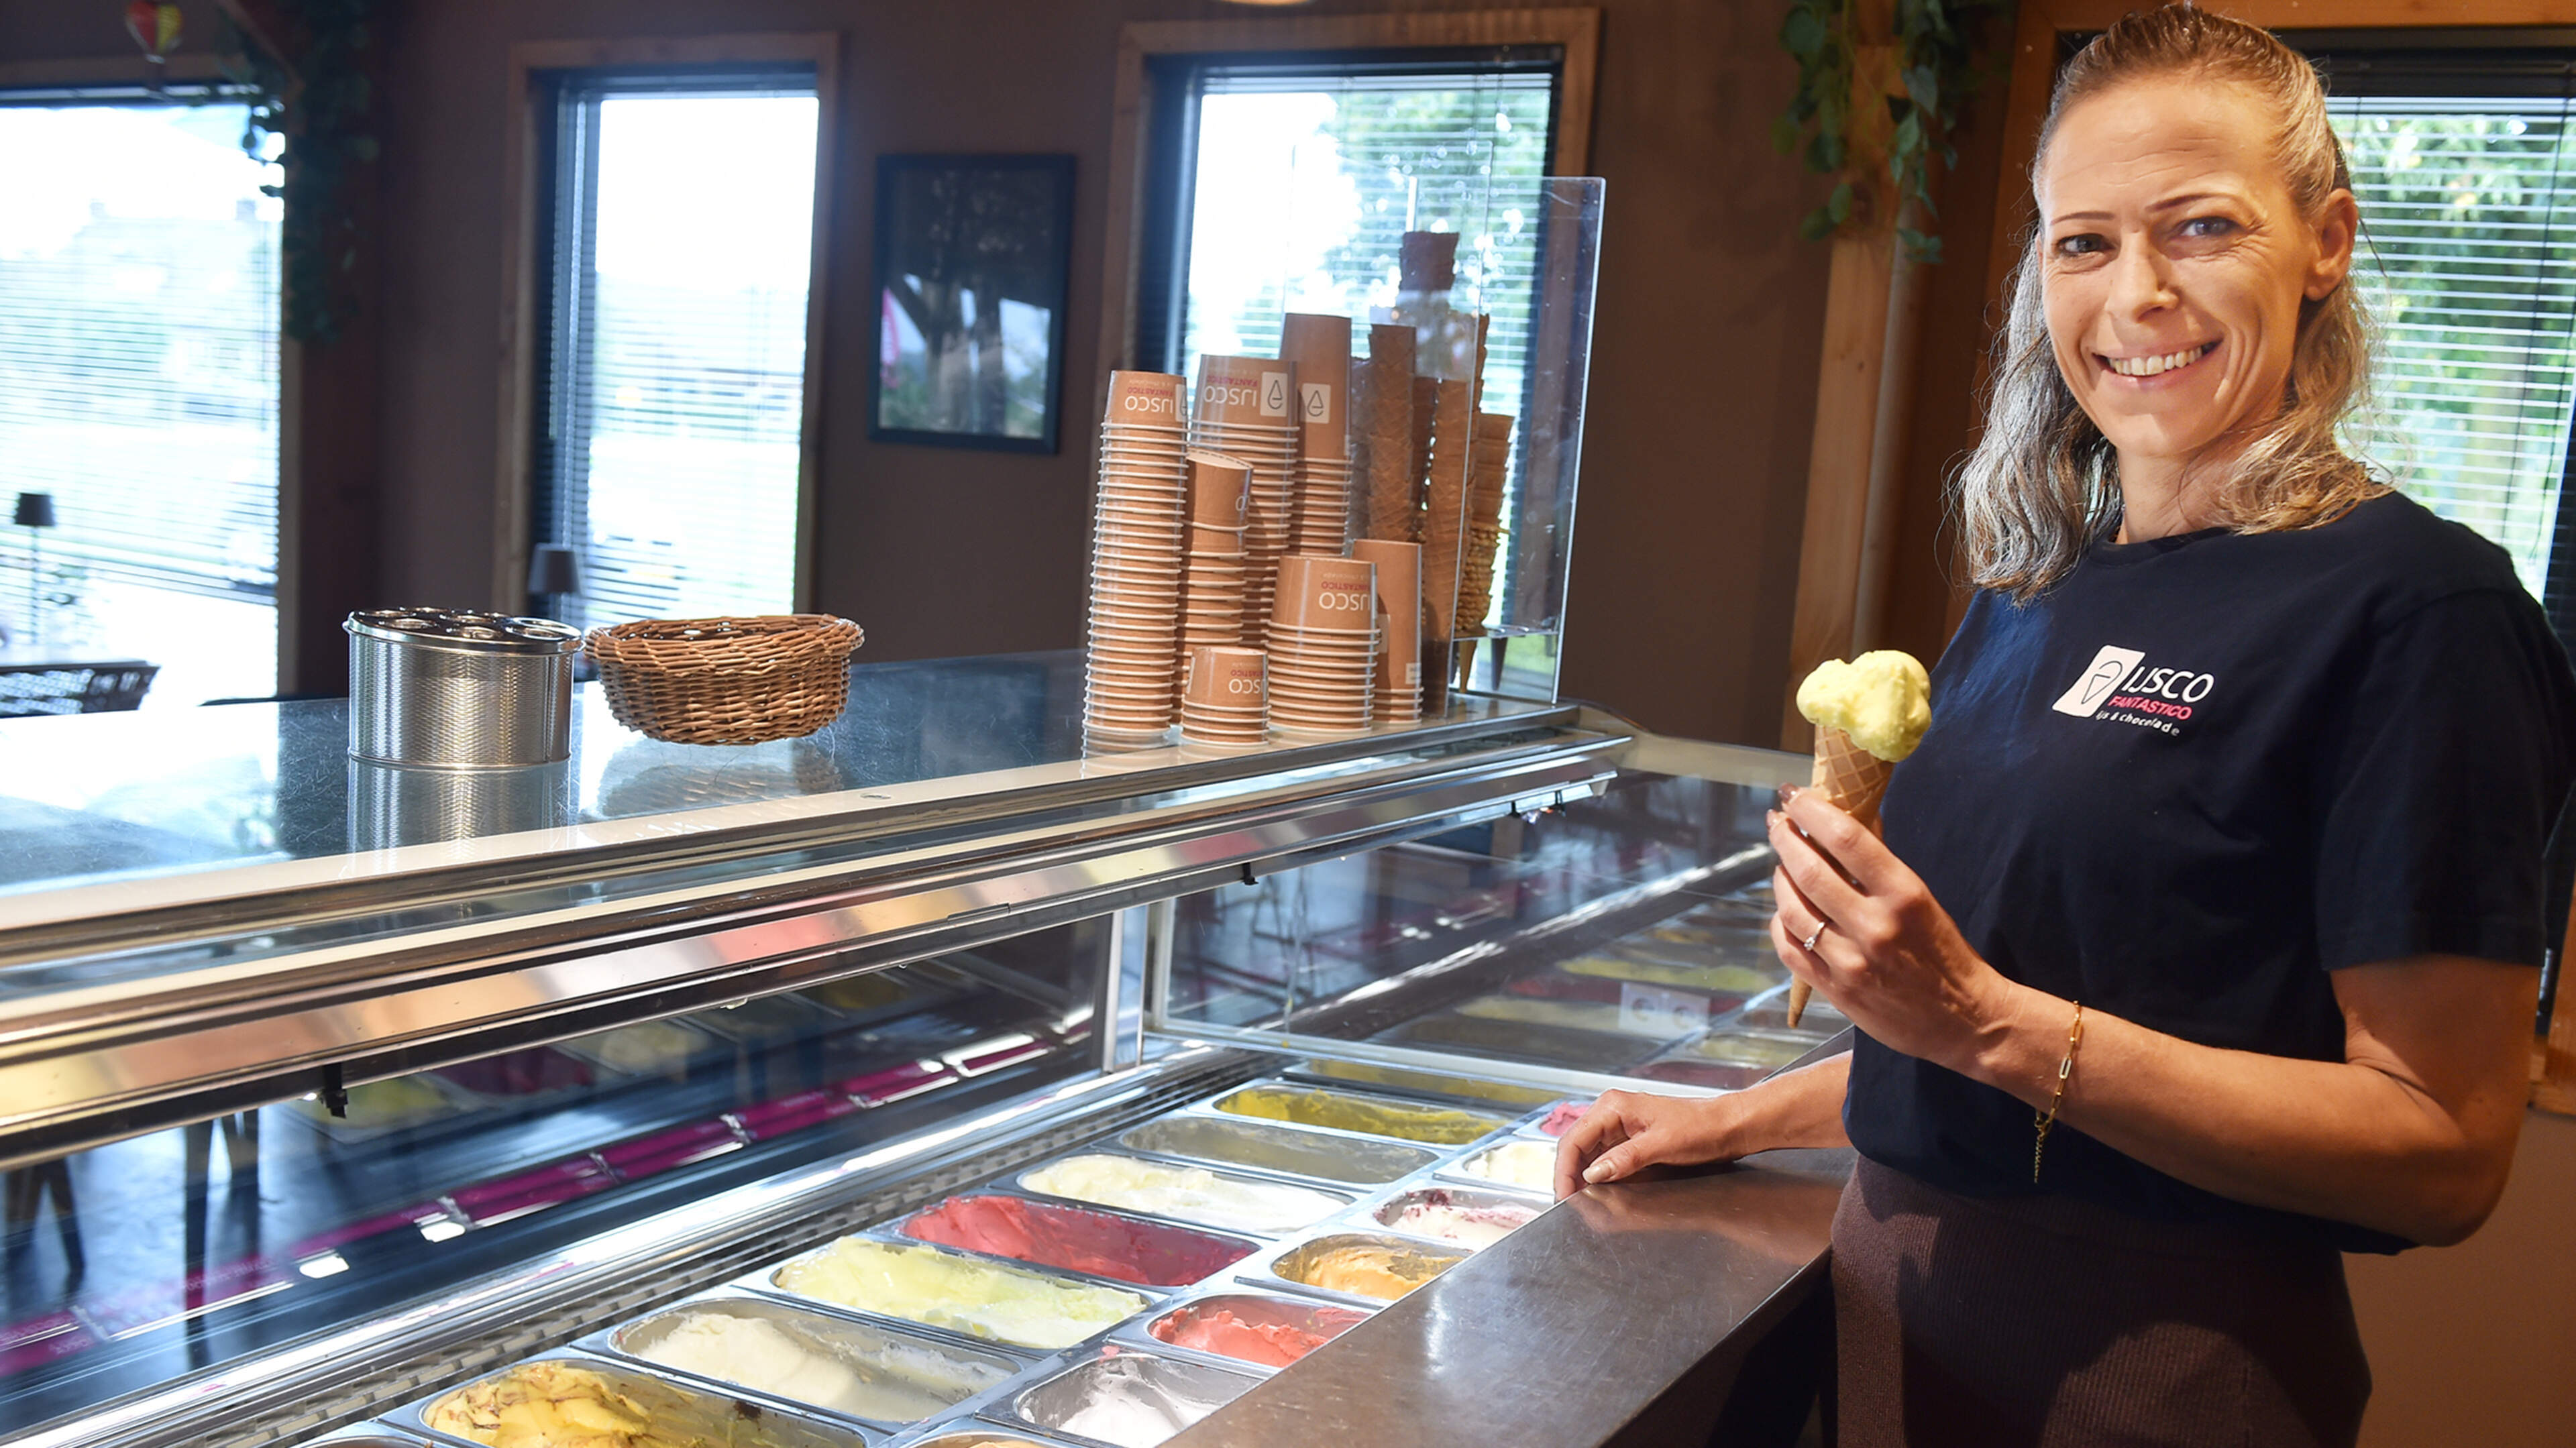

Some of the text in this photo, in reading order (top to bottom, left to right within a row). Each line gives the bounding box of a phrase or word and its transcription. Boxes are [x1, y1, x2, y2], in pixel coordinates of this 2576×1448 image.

[1124, 395, 1173, 414] IJSCO
[1203, 386, 1257, 407] IJSCO
[2121, 666, 2214, 703] IJSCO
[2107, 695, 2192, 720] FANTASTICO
